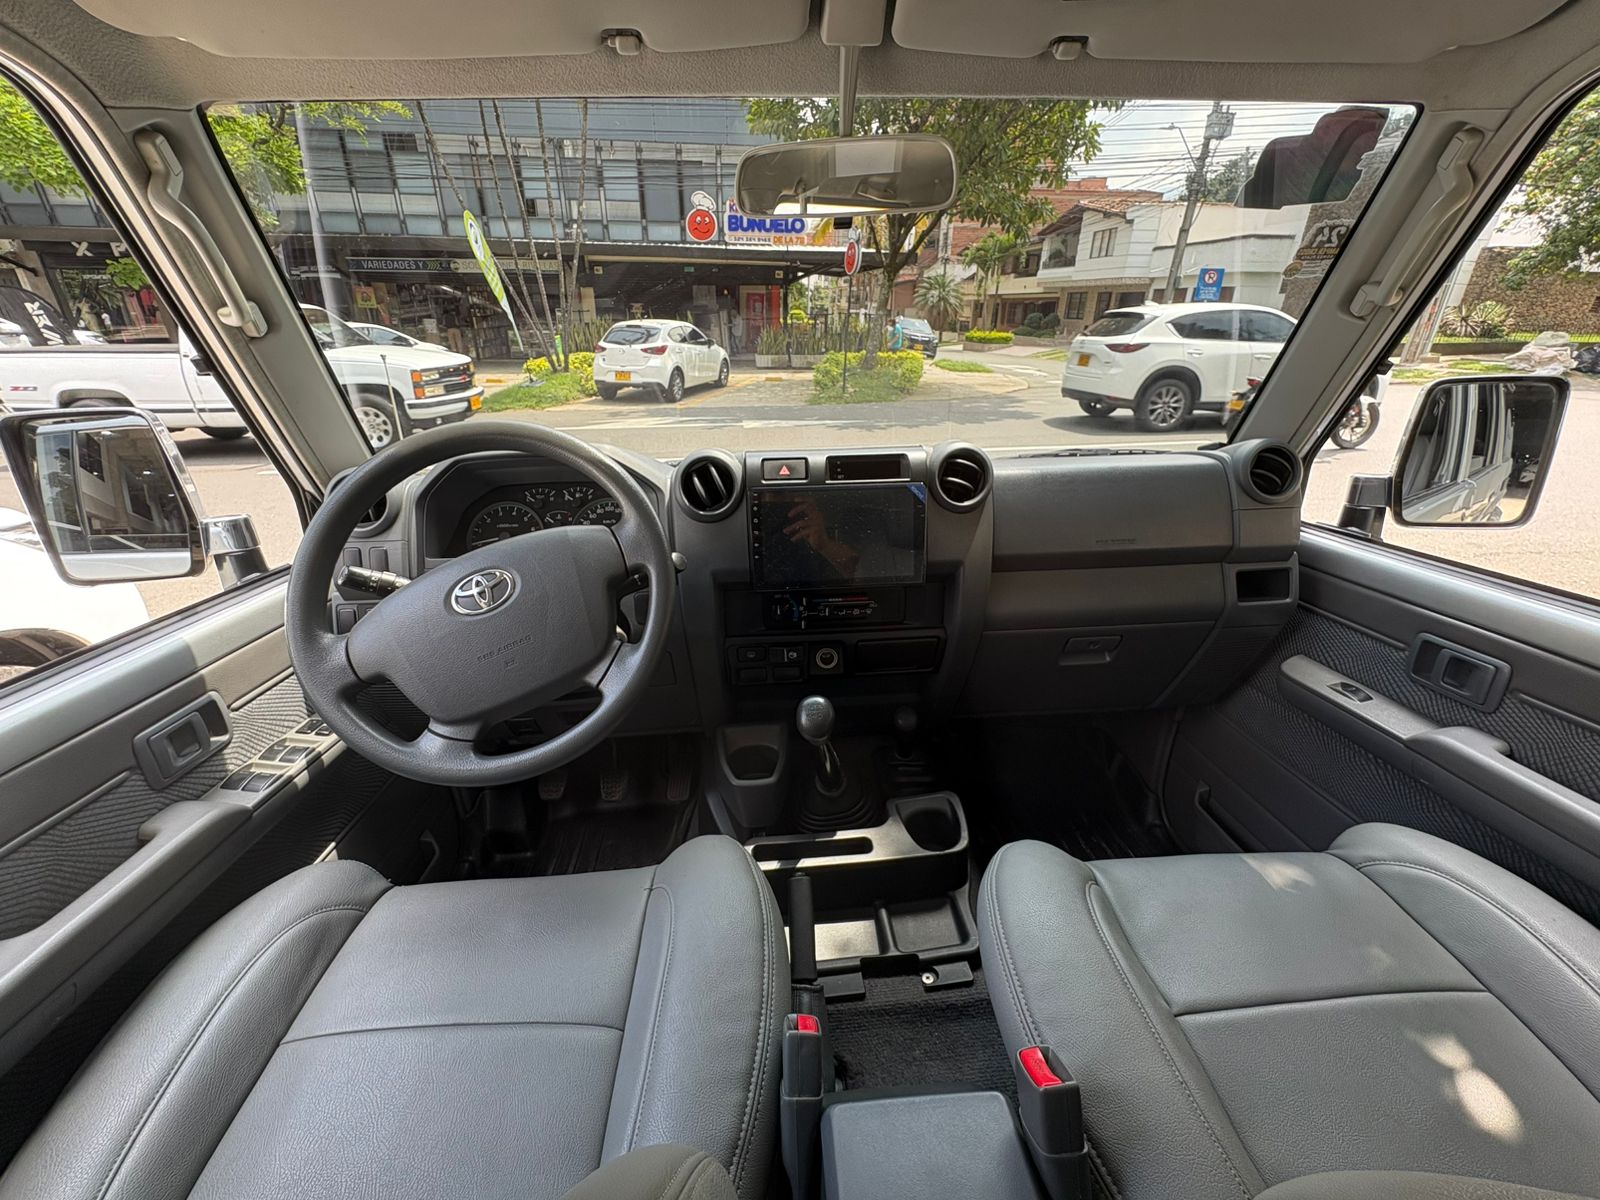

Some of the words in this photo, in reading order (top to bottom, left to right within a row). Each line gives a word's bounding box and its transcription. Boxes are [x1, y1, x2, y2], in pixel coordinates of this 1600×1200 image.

[773, 235, 783, 245] DE
[784, 236, 794, 245] LA
[71, 241, 94, 257] X
[361, 260, 416, 270] VARIEDADES
[417, 261, 424, 270] Y
[498, 634, 533, 655] AIRBAG
